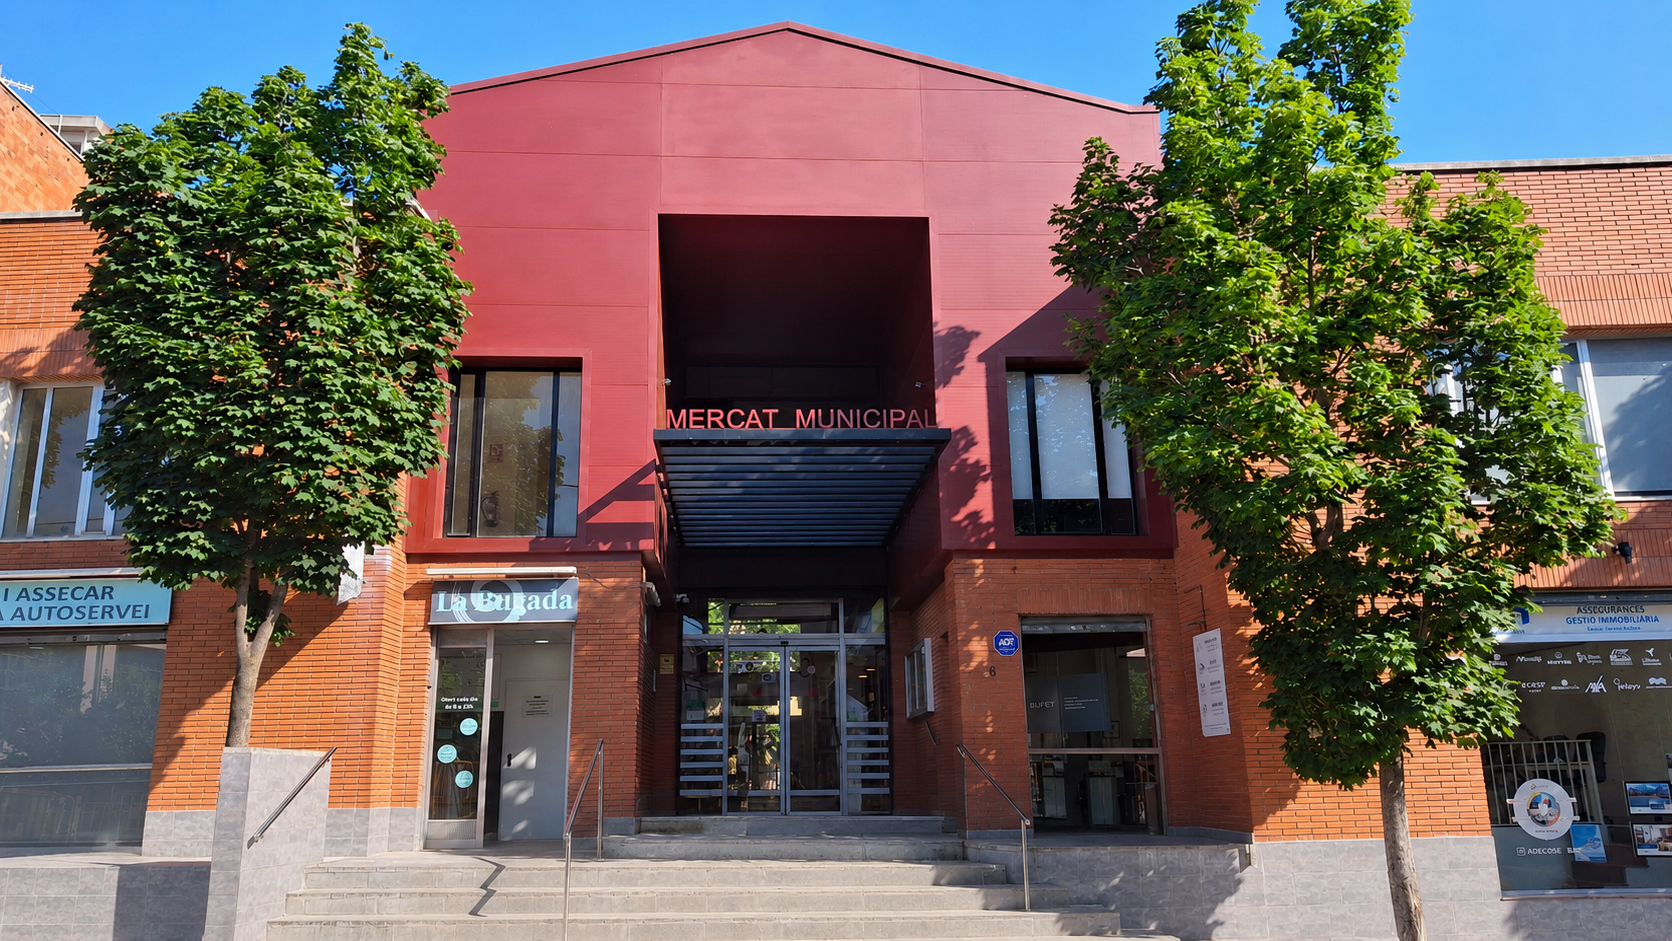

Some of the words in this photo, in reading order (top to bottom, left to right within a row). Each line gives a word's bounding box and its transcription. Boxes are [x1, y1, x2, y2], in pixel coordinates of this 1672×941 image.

[666, 409, 779, 429] MERCAT
[795, 409, 938, 429] MUNICIPAL
[3, 588, 9, 601] I
[15, 586, 115, 602] ASSECAR
[436, 591, 468, 612] La
[10, 604, 150, 621] AUTOSERVEI
[1576, 605, 1645, 614] ASSEGURANCES
[989, 665, 997, 677] 6
